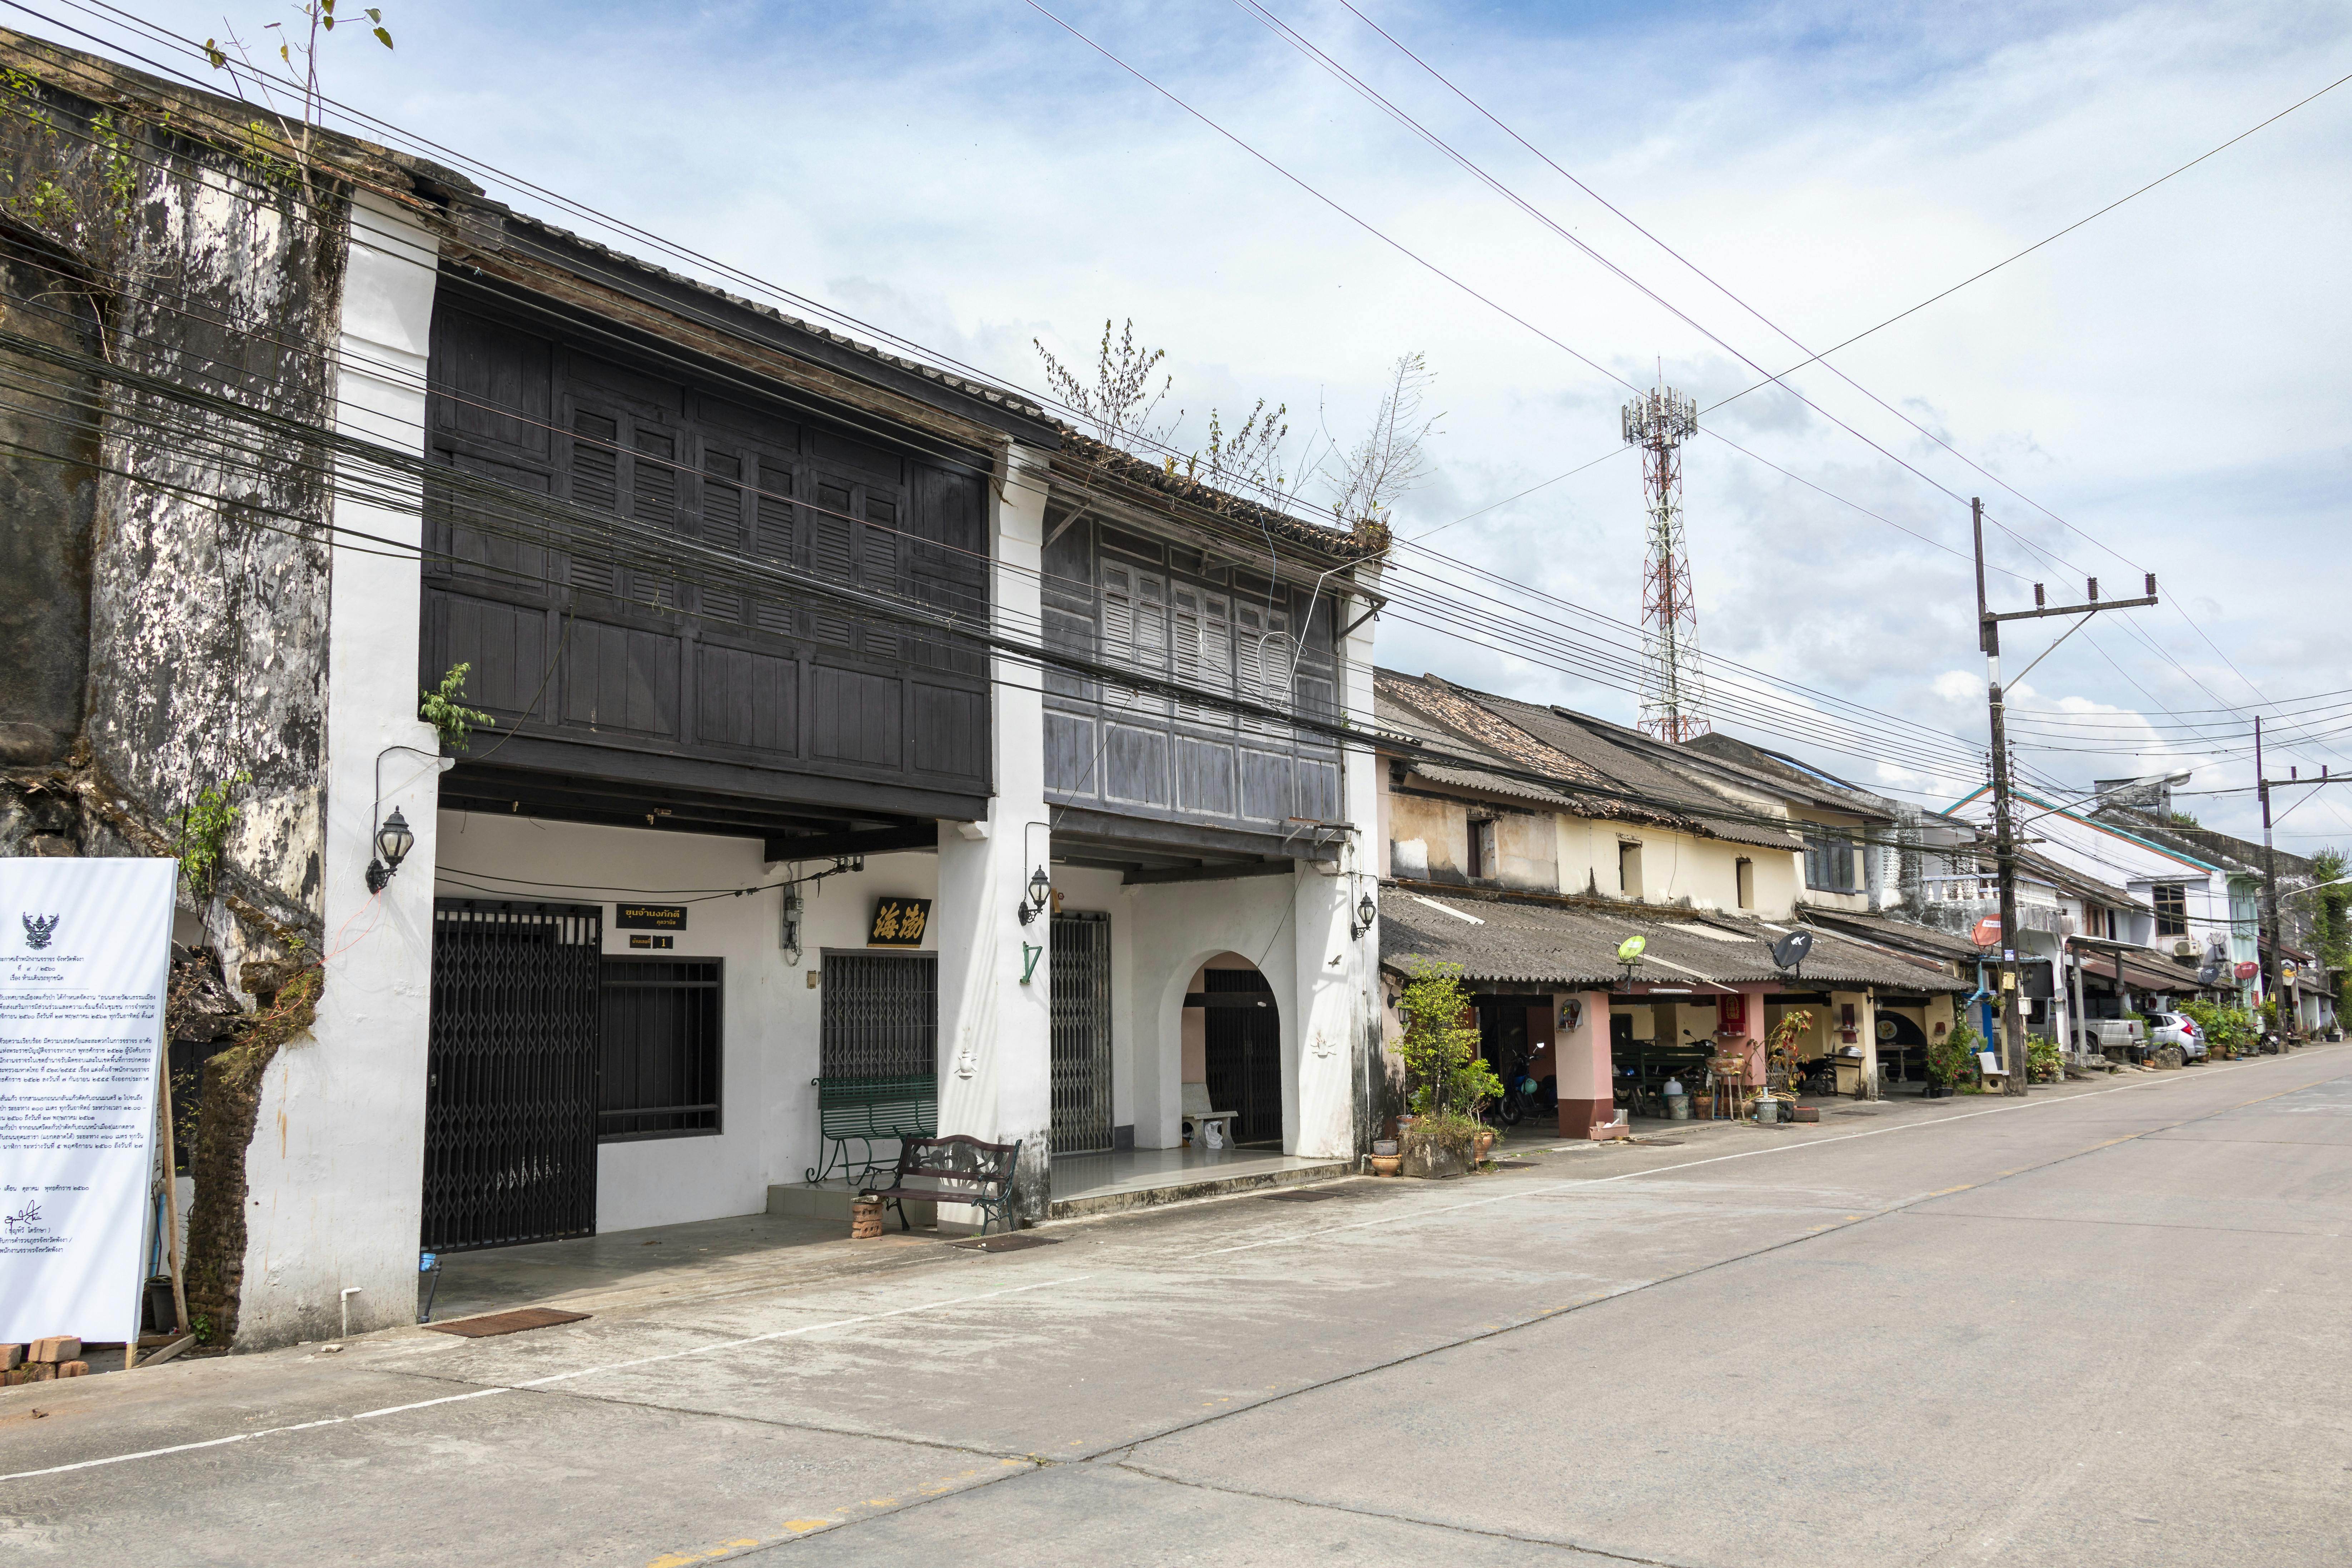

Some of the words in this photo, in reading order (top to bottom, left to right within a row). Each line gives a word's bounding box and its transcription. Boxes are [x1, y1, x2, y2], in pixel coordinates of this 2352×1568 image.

[625, 908, 680, 918] ขุนจำนงภักดี
[661, 938, 666, 947] 1
[22, 974, 64, 982] ห้ามเดินรถทุกชนิด
[109, 1012, 140, 1020] ทุกวันอาทิตย์
[141, 1011, 154, 1019] ตั้งแต่
[125, 1046, 151, 1055] ผู้บังคับการ
[59, 1104, 91, 1112] ทุกวันอาทิตย์
[44, 1184, 72, 1193] พุทธศักราช
